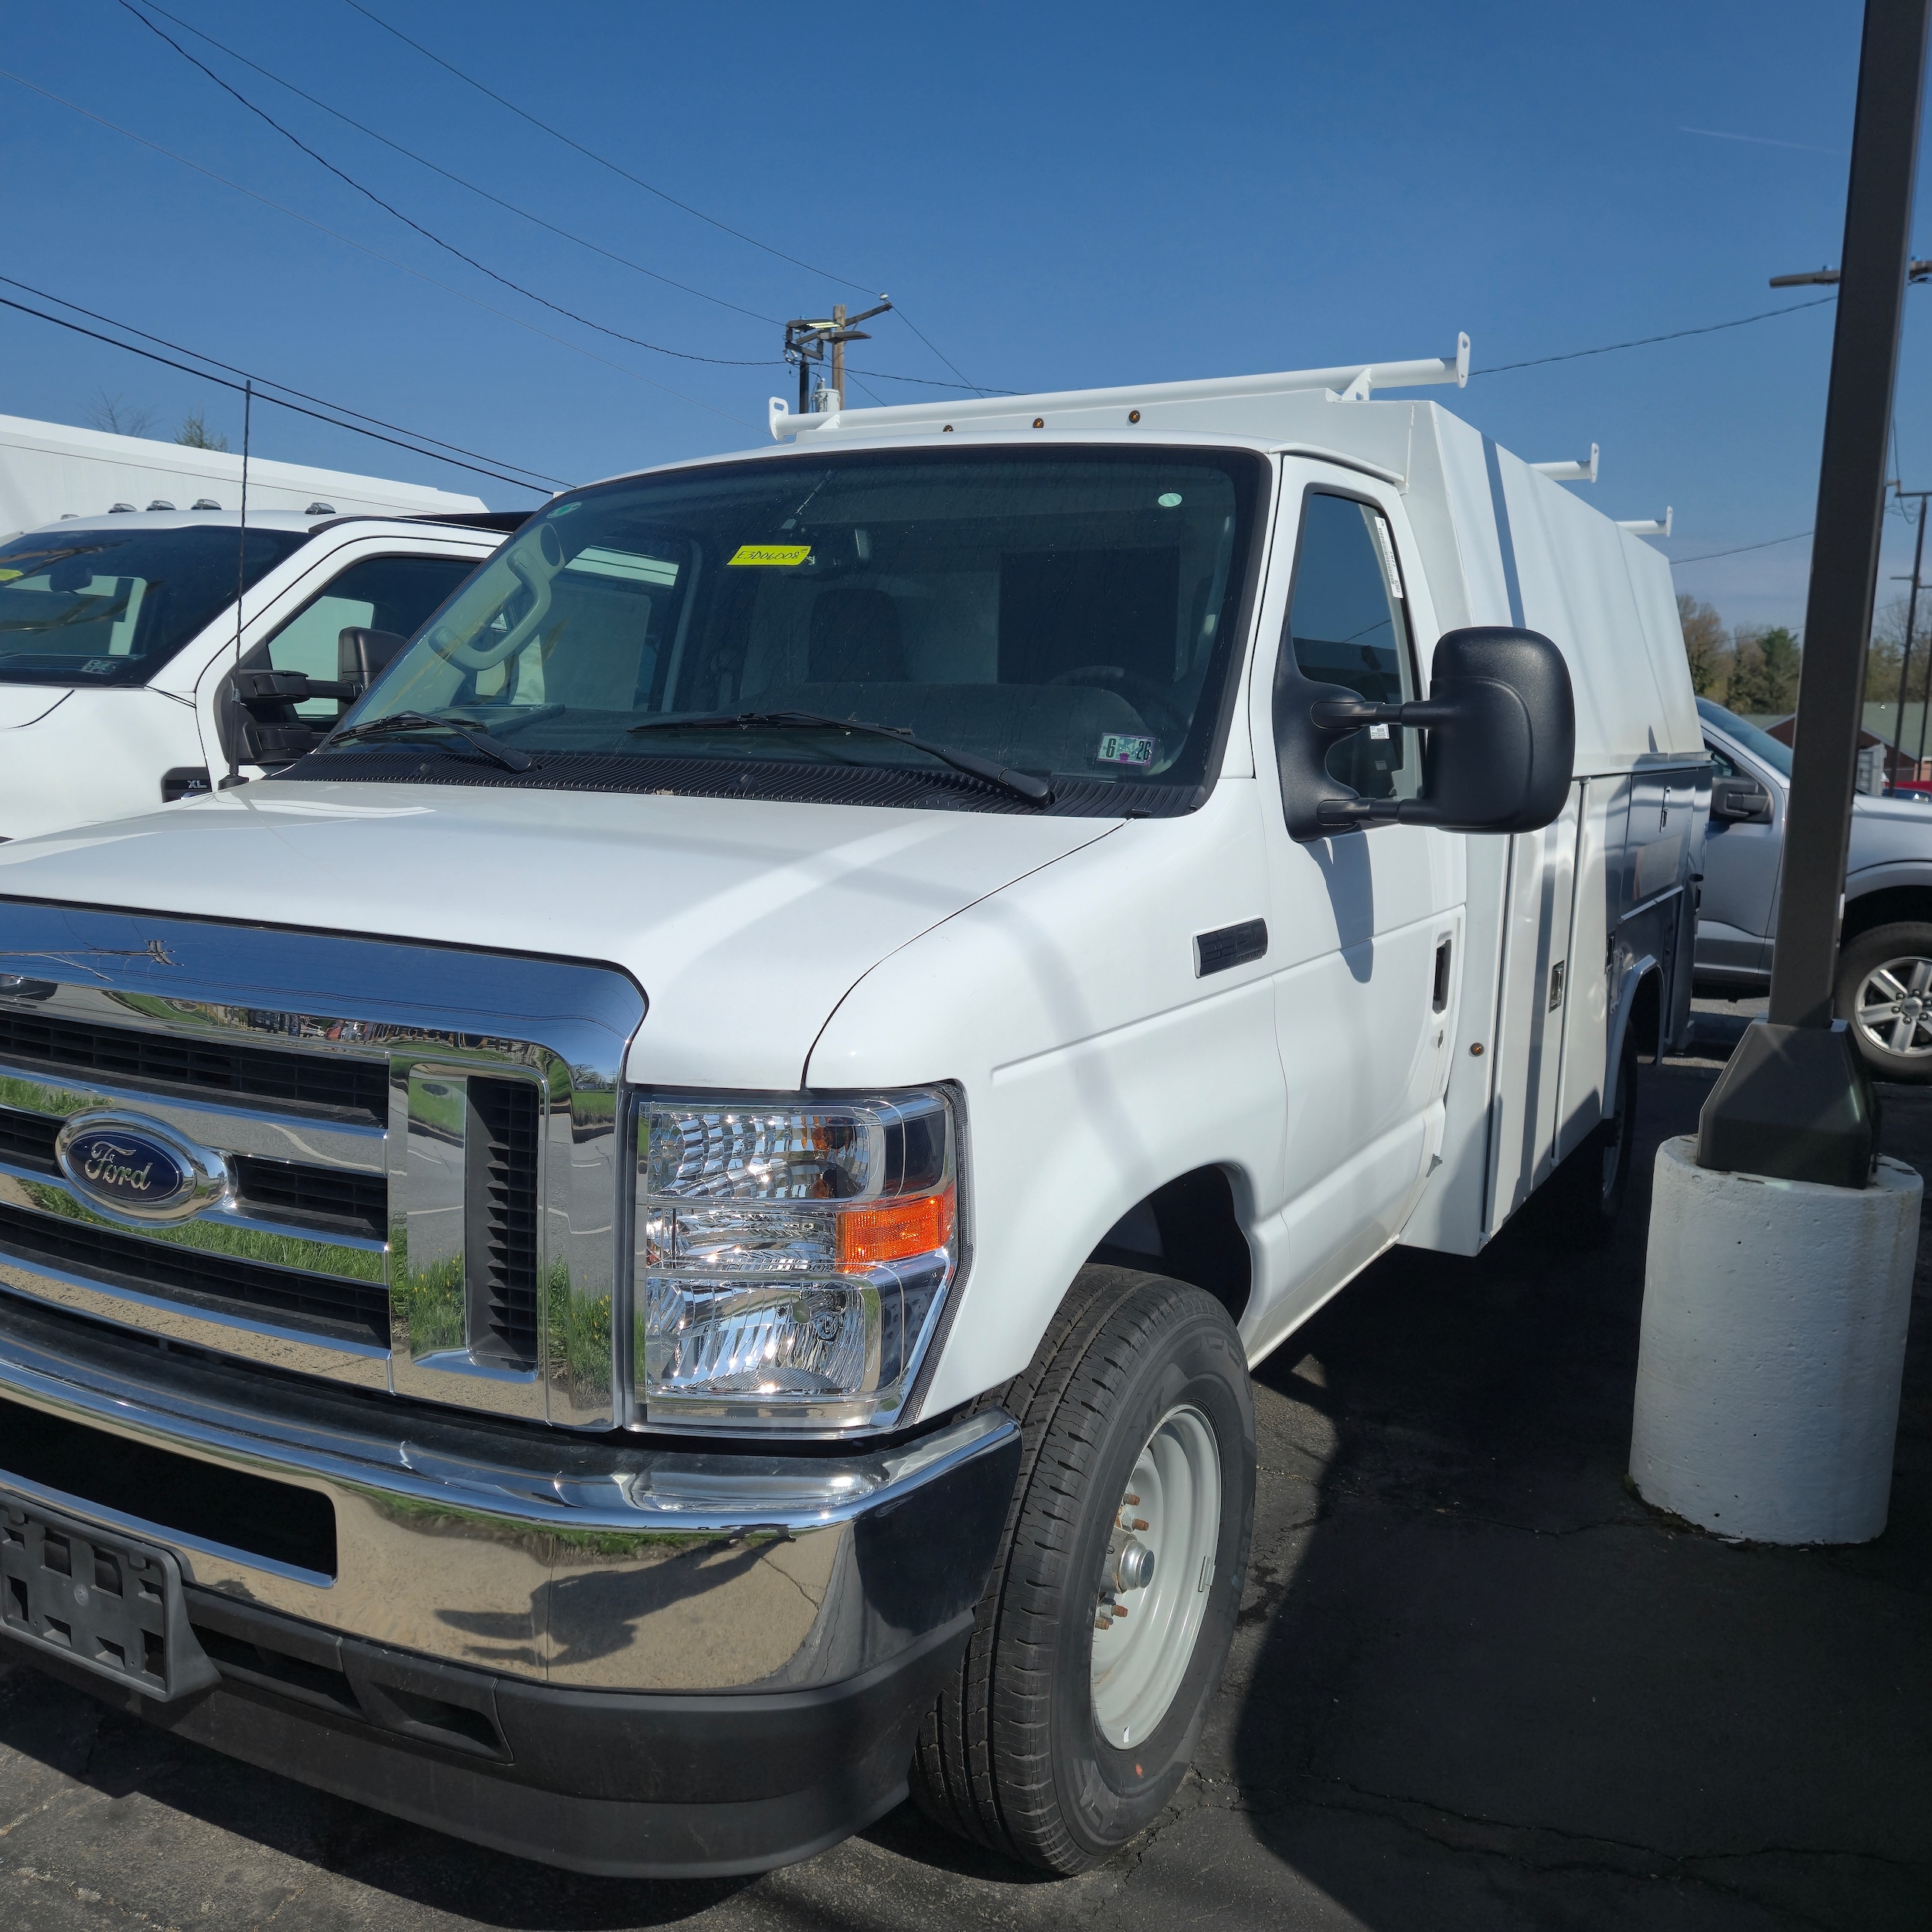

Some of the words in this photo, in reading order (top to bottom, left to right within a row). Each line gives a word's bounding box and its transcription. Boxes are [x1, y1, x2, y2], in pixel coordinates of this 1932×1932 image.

[1106, 738, 1117, 758] 6
[1136, 740, 1151, 760] 26
[187, 780, 207, 789] XL
[84, 1141, 154, 1191] Ford
